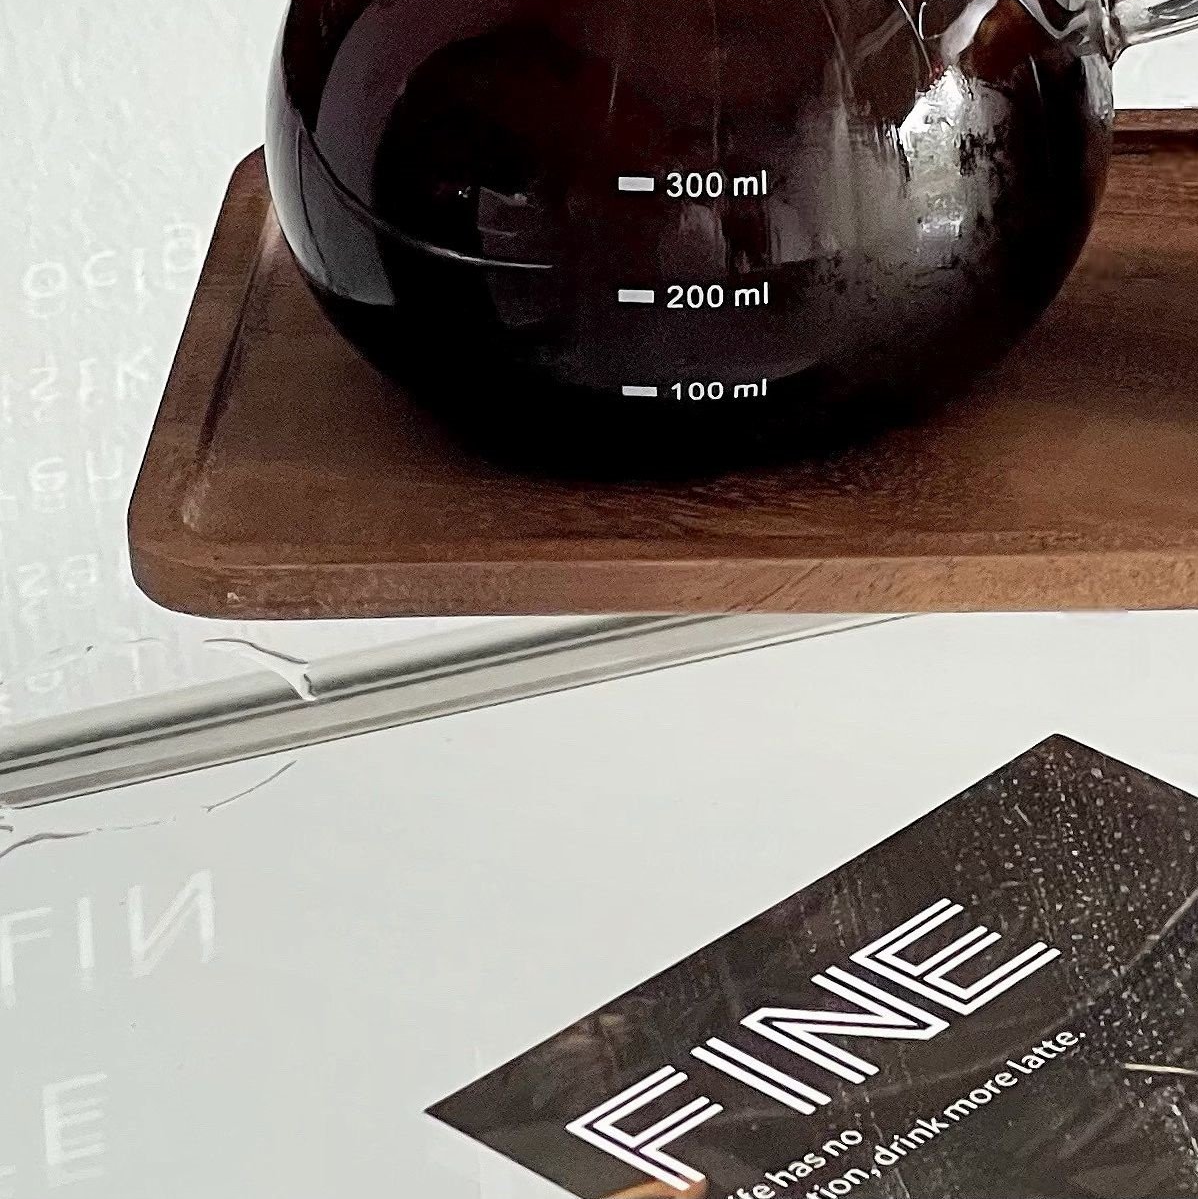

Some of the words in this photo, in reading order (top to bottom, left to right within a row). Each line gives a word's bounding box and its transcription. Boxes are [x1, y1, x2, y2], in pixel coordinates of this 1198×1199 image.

[666, 171, 723, 198] 300
[733, 169, 767, 197] ml
[666, 284, 724, 309] 200
[734, 281, 769, 307] ml
[670, 381, 724, 401] 100
[733, 378, 767, 399] ml
[564, 897, 1061, 1192] FINE
[873, 1117, 950, 1166] drink
[943, 1071, 1018, 1121] more
[1006, 1031, 1087, 1074] latte.
[763, 1152, 827, 1188] has
[821, 1130, 863, 1157] no
